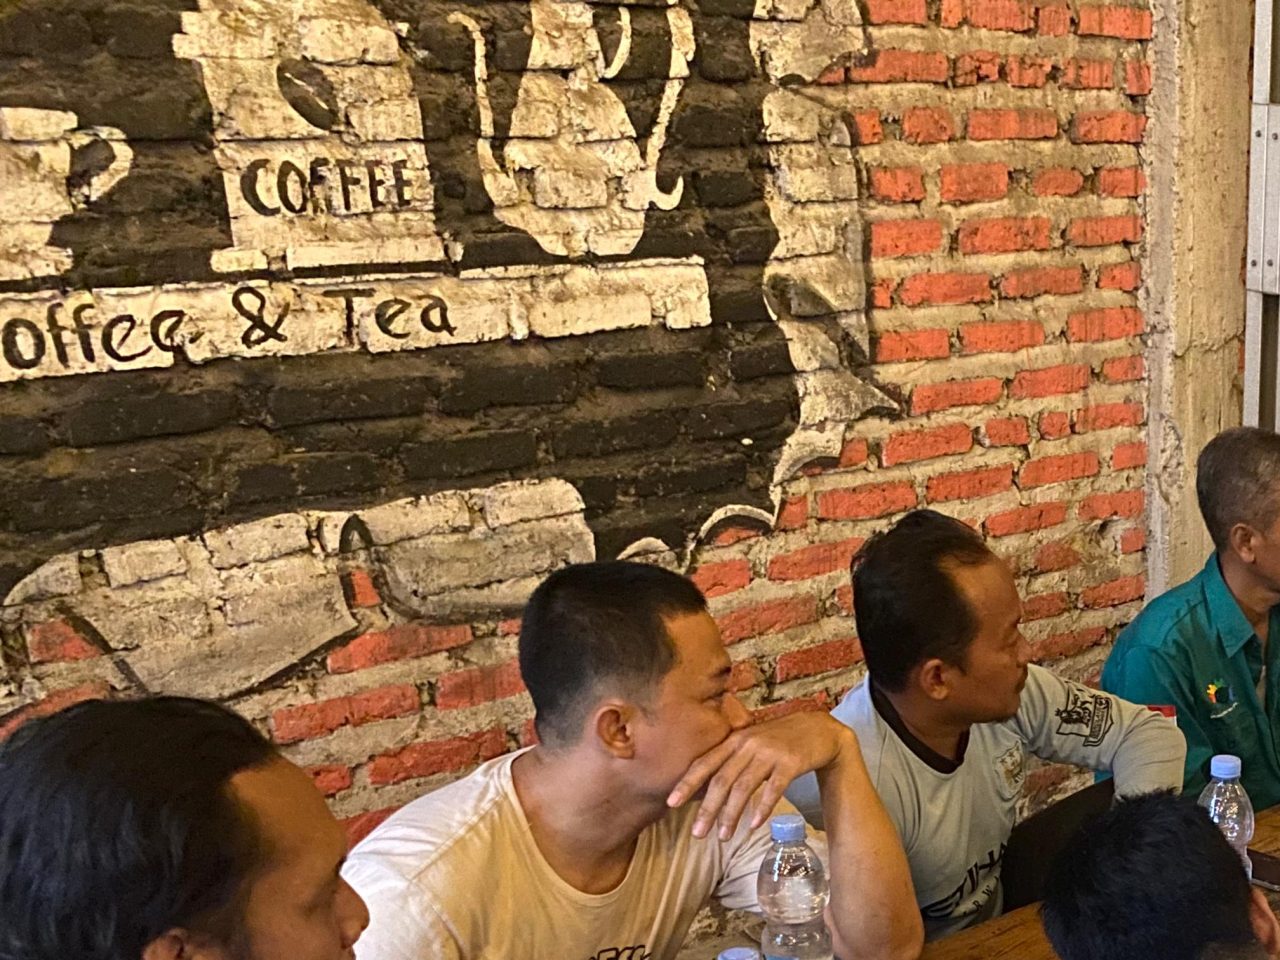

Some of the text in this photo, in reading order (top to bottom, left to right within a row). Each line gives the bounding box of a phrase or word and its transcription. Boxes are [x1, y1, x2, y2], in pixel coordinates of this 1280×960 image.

[239, 157, 413, 217] COFFEE
[1, 285, 458, 371] offee & Tea
